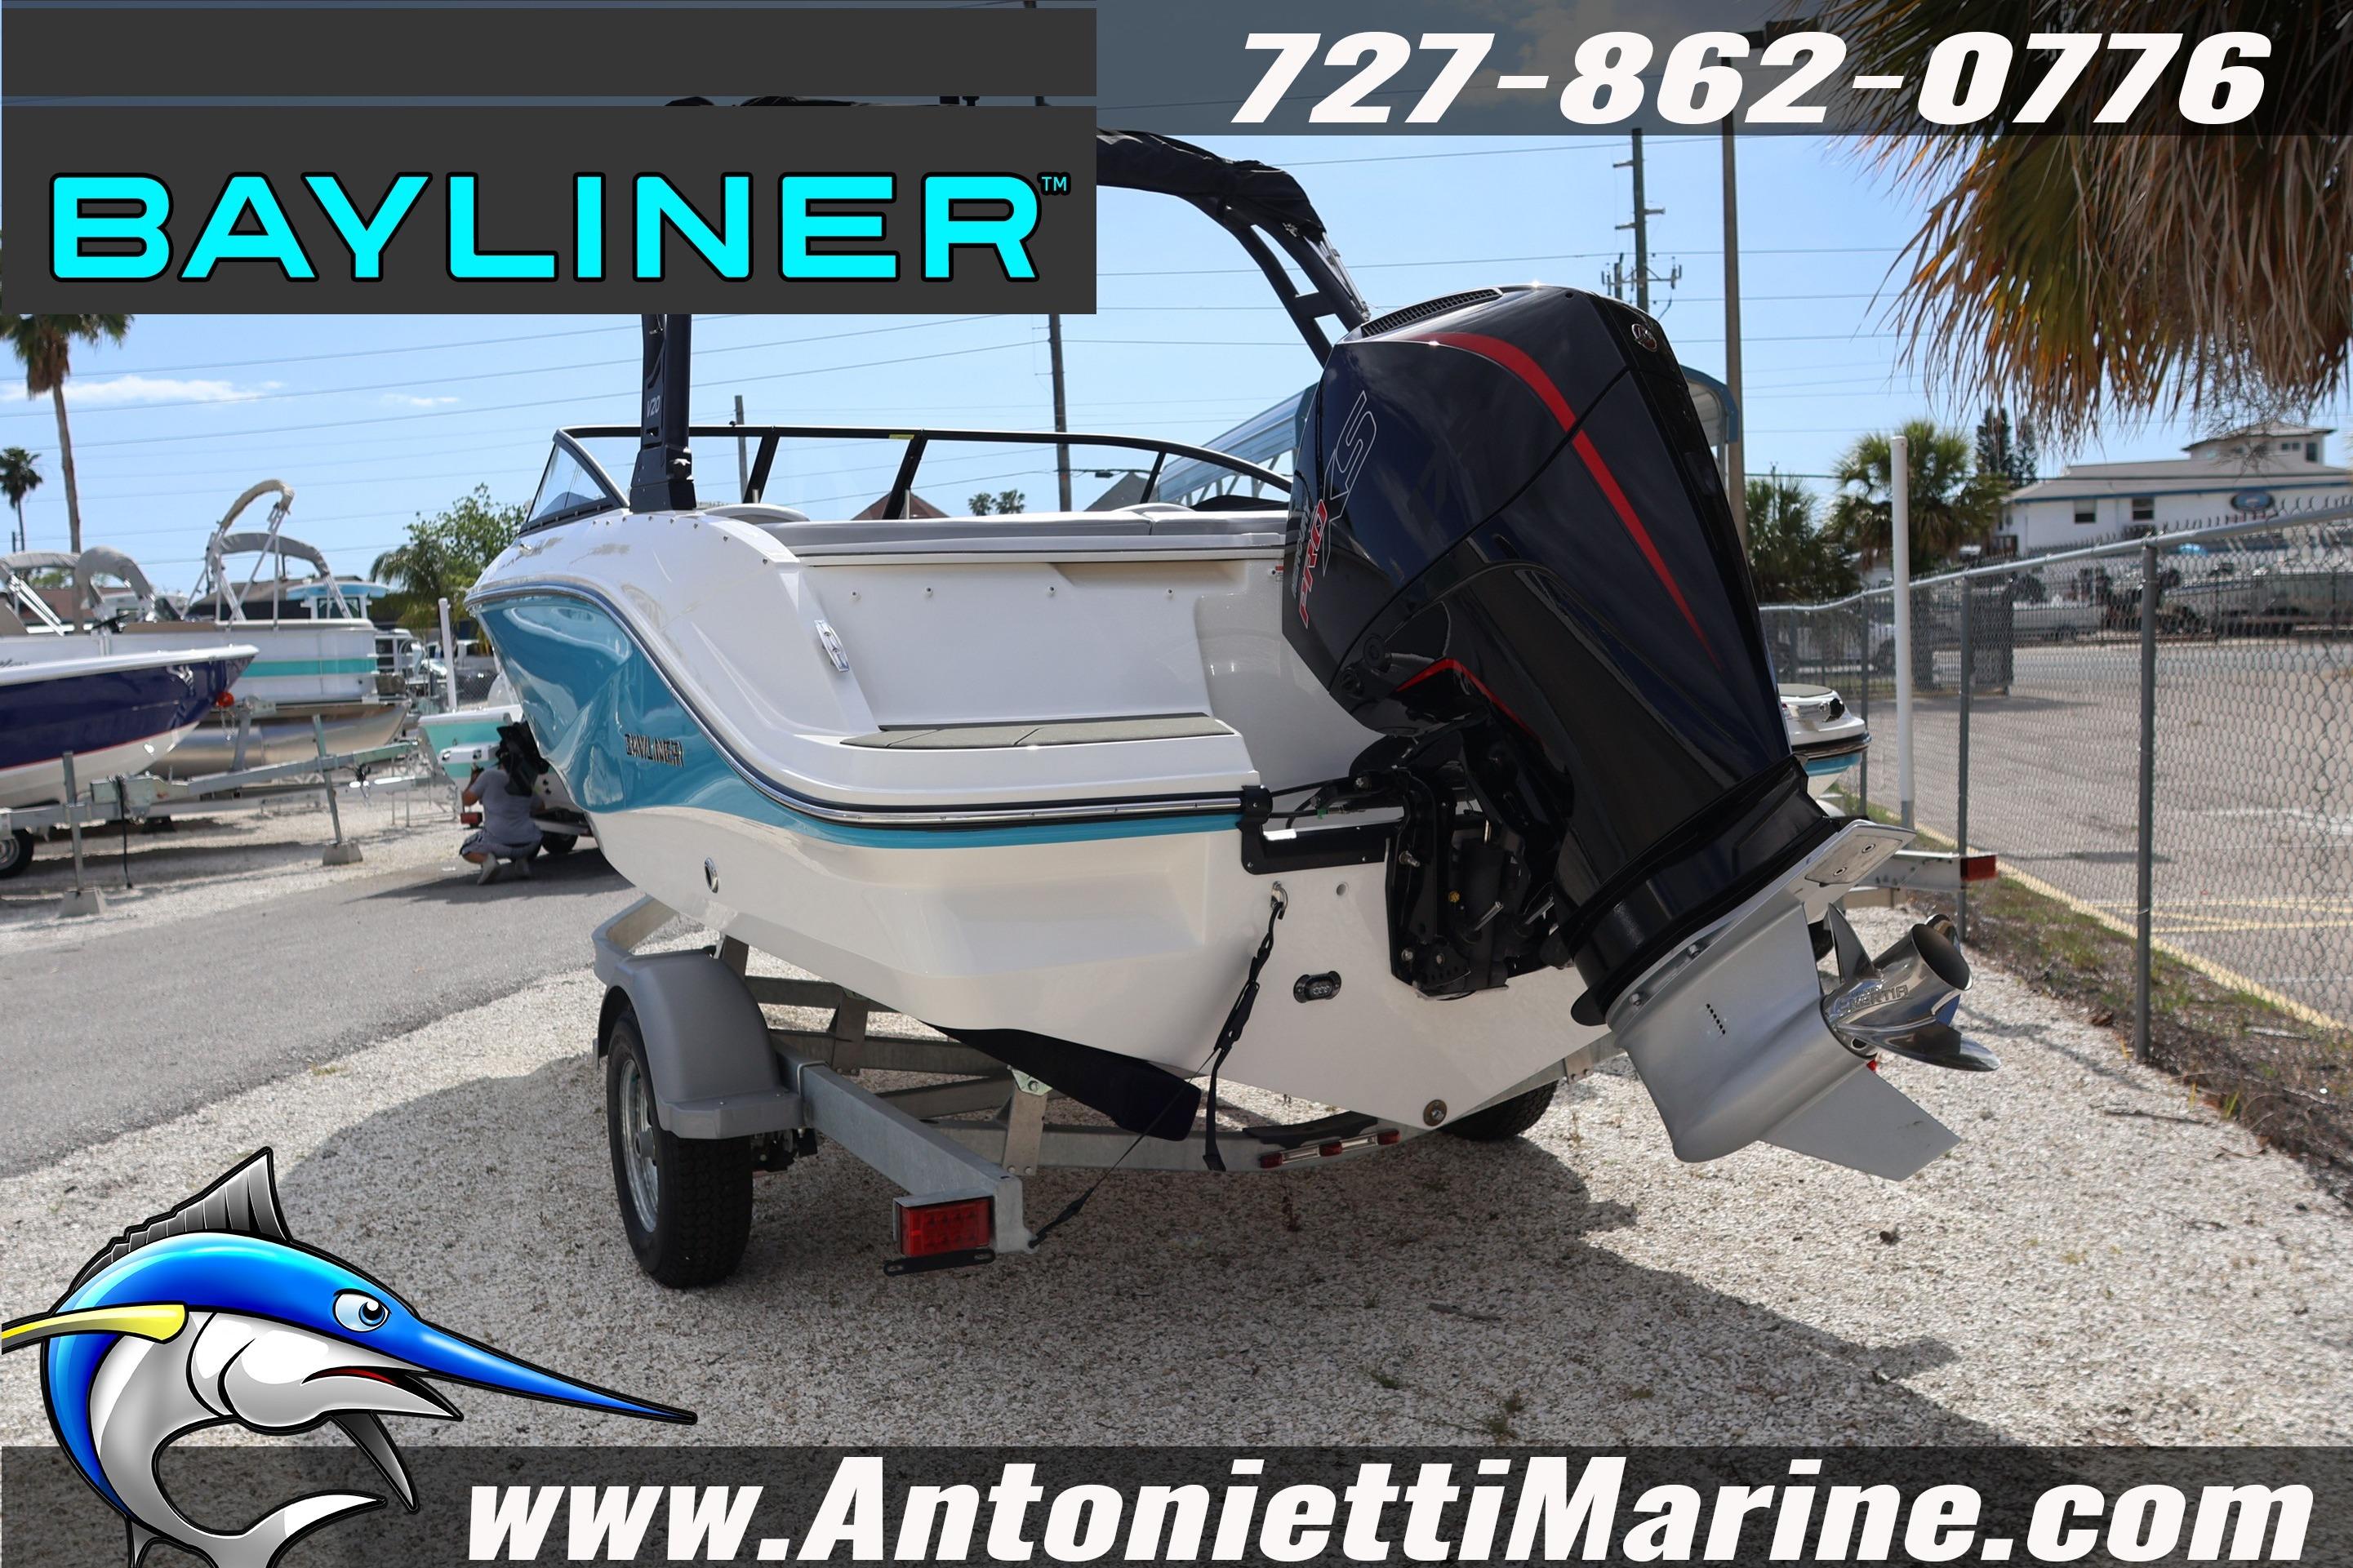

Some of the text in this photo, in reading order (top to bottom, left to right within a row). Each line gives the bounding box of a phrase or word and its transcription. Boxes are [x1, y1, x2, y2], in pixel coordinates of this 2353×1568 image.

[647, 395, 661, 418] V20
[1299, 390, 1377, 629] PRO XS
[625, 734, 684, 767] BAYLINER
